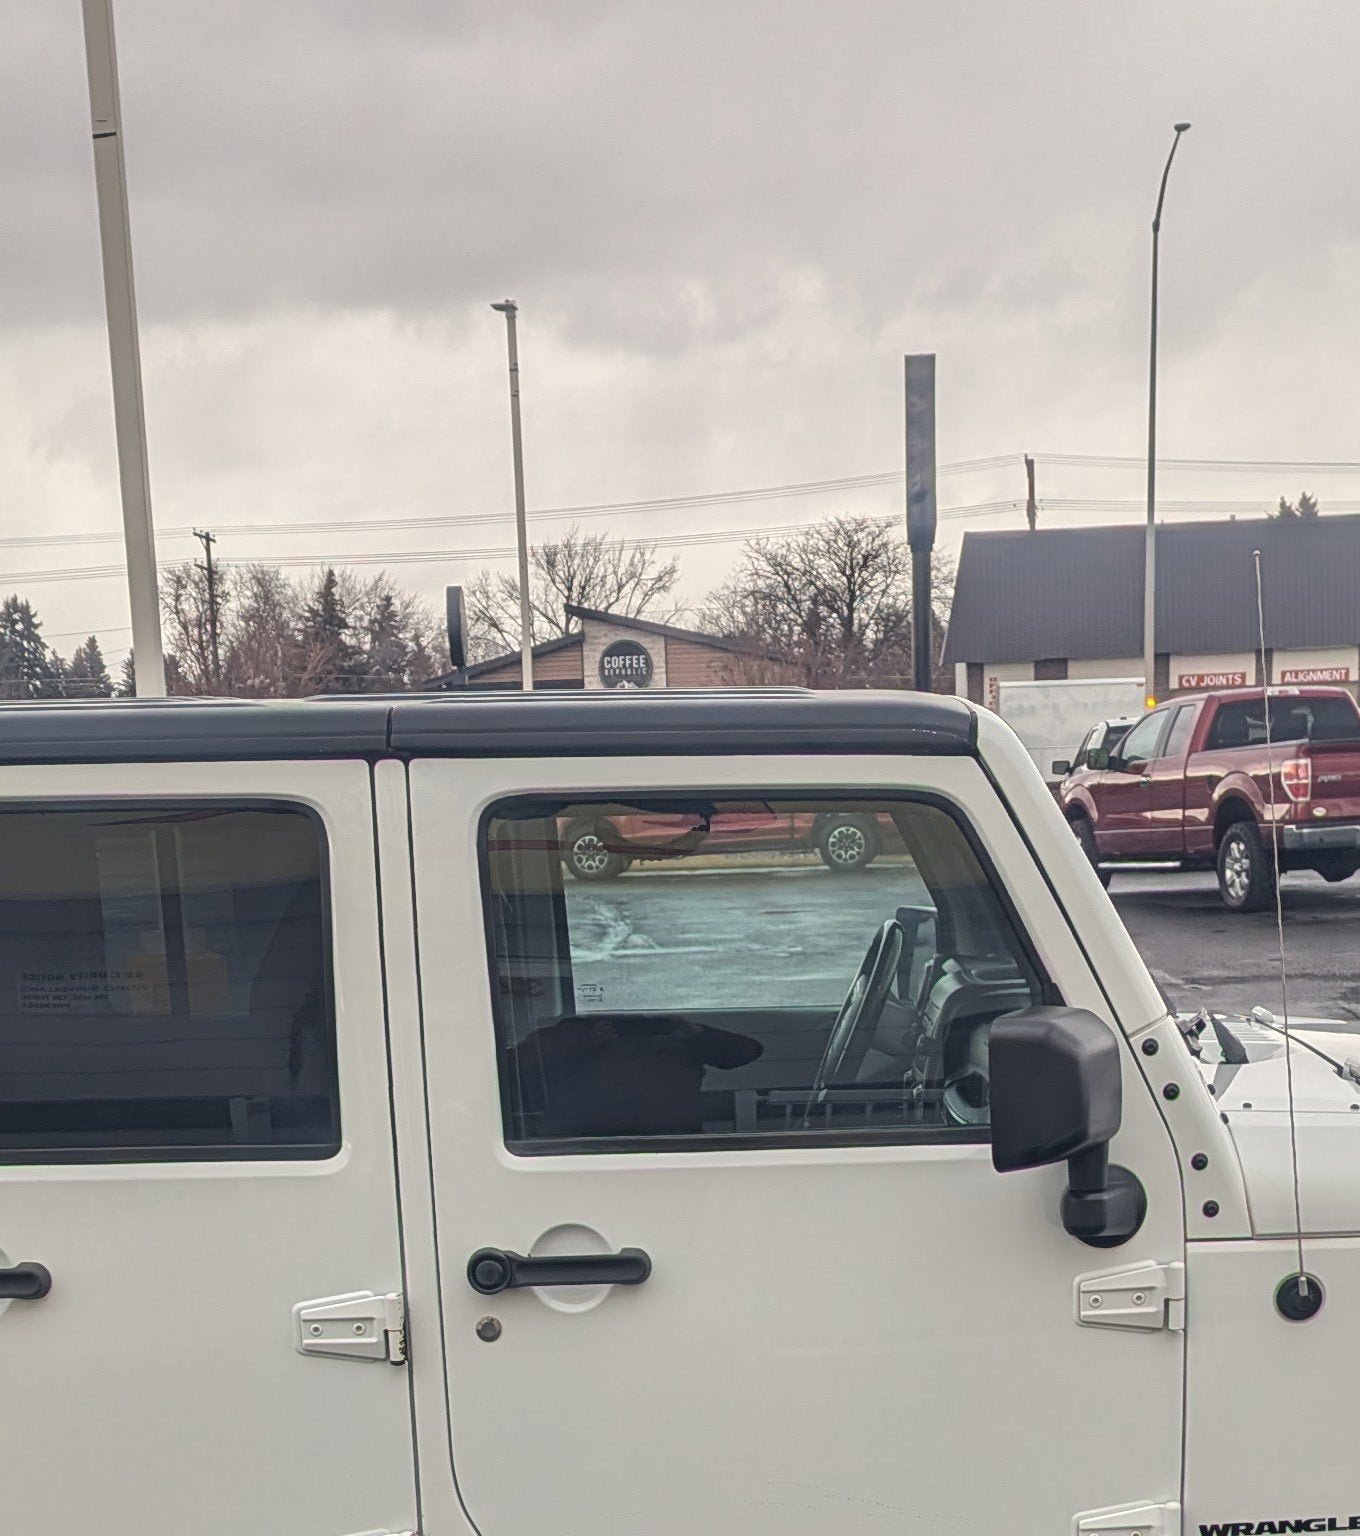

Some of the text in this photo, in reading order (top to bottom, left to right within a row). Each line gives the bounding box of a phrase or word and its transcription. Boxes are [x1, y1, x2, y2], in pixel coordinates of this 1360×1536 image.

[603, 655, 647, 669] COFFEE
[604, 668, 647, 676] REPUBLIC
[1283, 669, 1348, 682] ALIGNMENT
[1181, 673, 1242, 688] CV JOINTS
